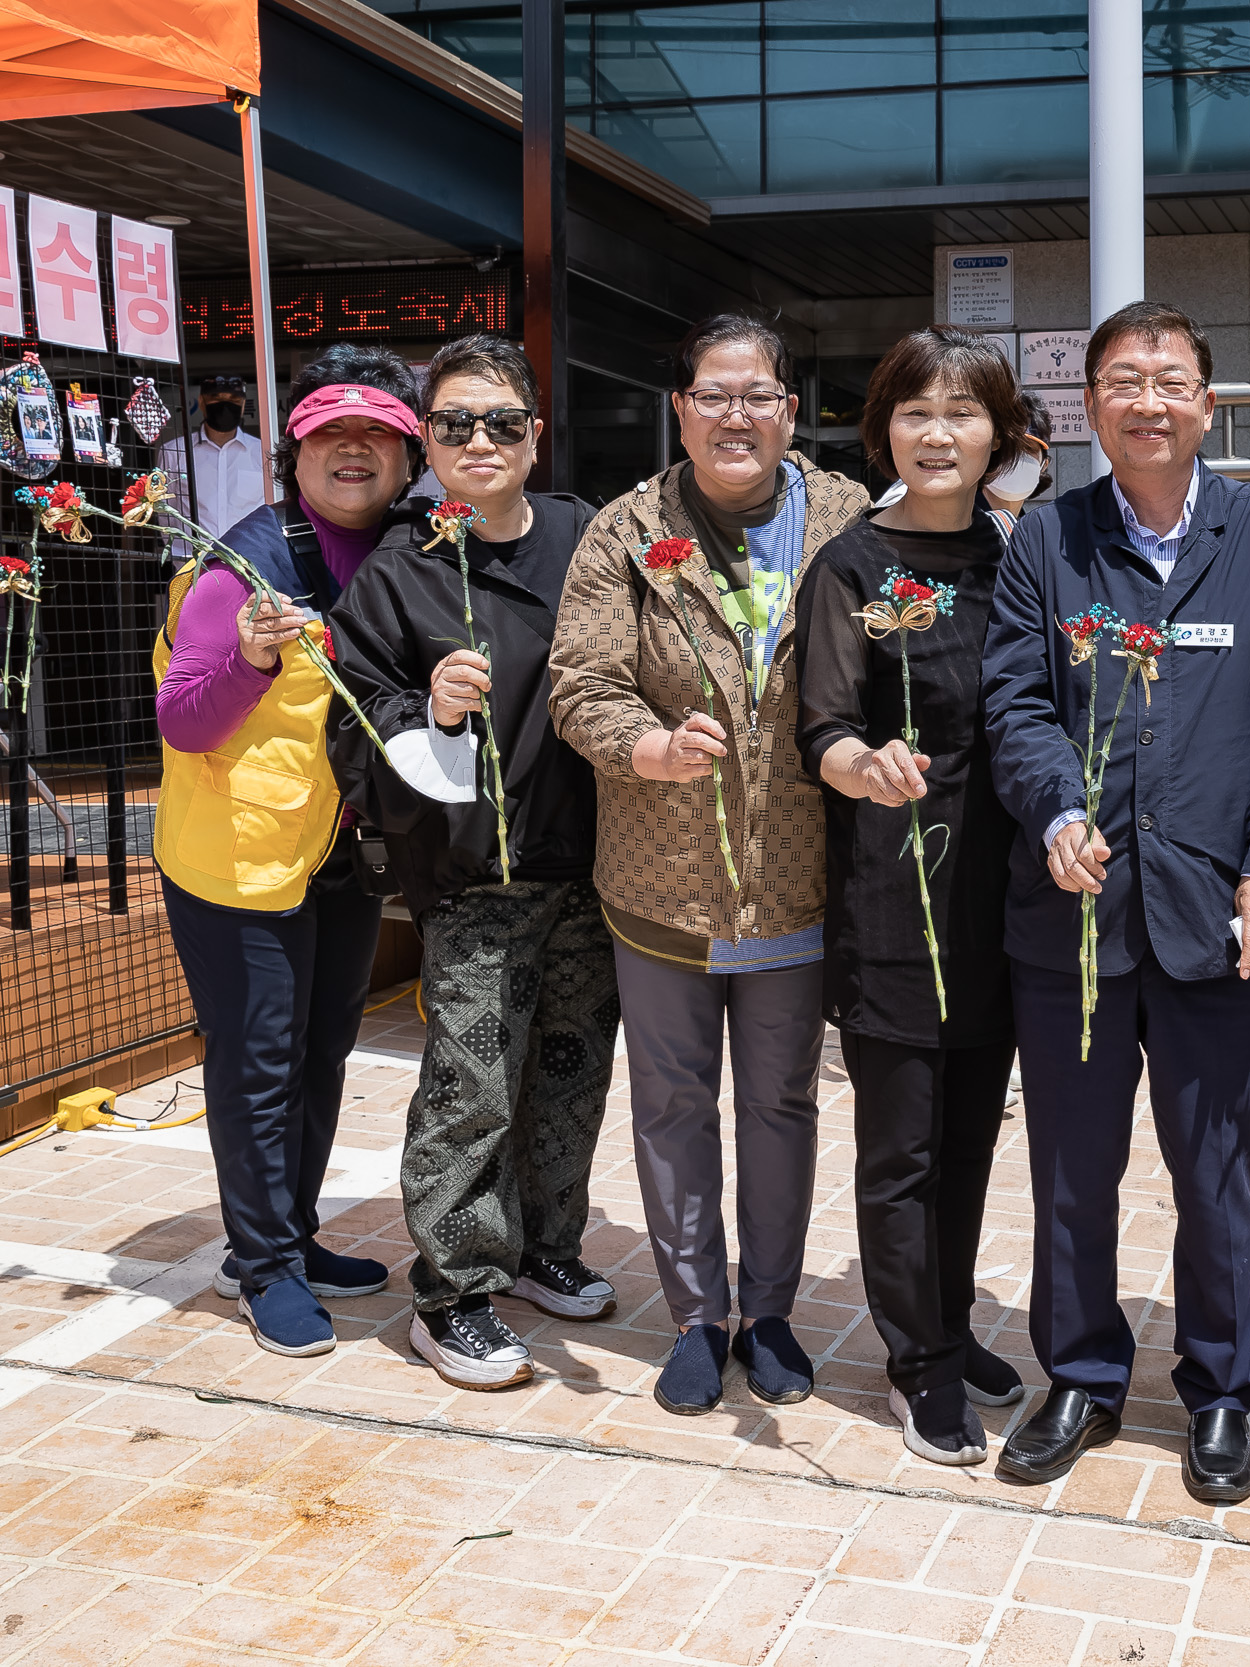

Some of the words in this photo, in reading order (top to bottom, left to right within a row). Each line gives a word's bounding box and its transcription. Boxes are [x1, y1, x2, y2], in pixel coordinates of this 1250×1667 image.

[955, 259, 977, 267] CCTV
[1035, 370, 1081, 379] 평생학습관
[1195, 627, 1228, 636] 김경호
